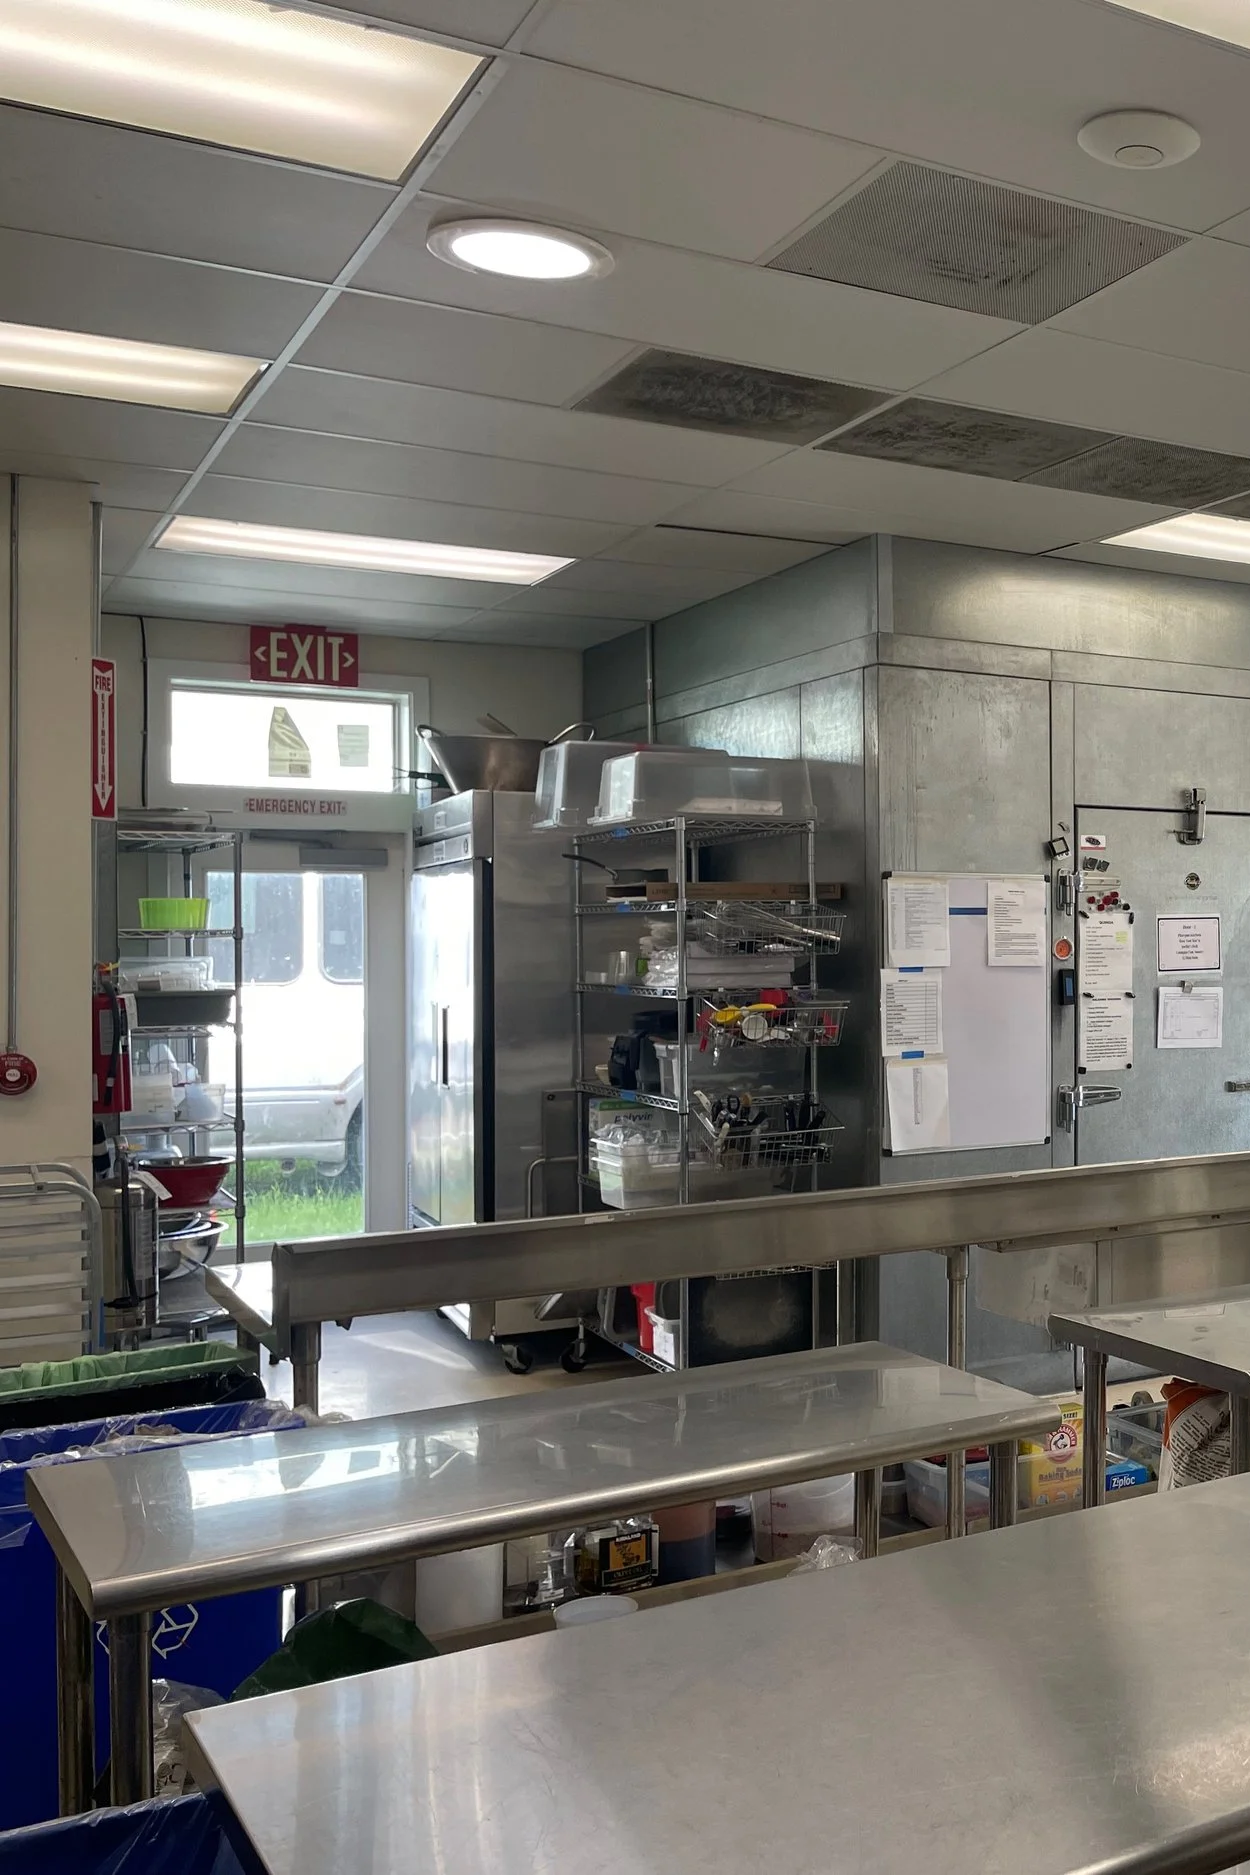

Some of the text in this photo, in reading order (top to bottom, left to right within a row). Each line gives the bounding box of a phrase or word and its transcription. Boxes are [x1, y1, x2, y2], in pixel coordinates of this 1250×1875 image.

[269, 631, 344, 682] EXIT
[95, 675, 111, 692] FIRE
[248, 798, 343, 815] EMERGENCY EXIT
[1063, 1411, 1078, 1419] SIZE!
[1111, 1475, 1136, 1489] Ziploc
